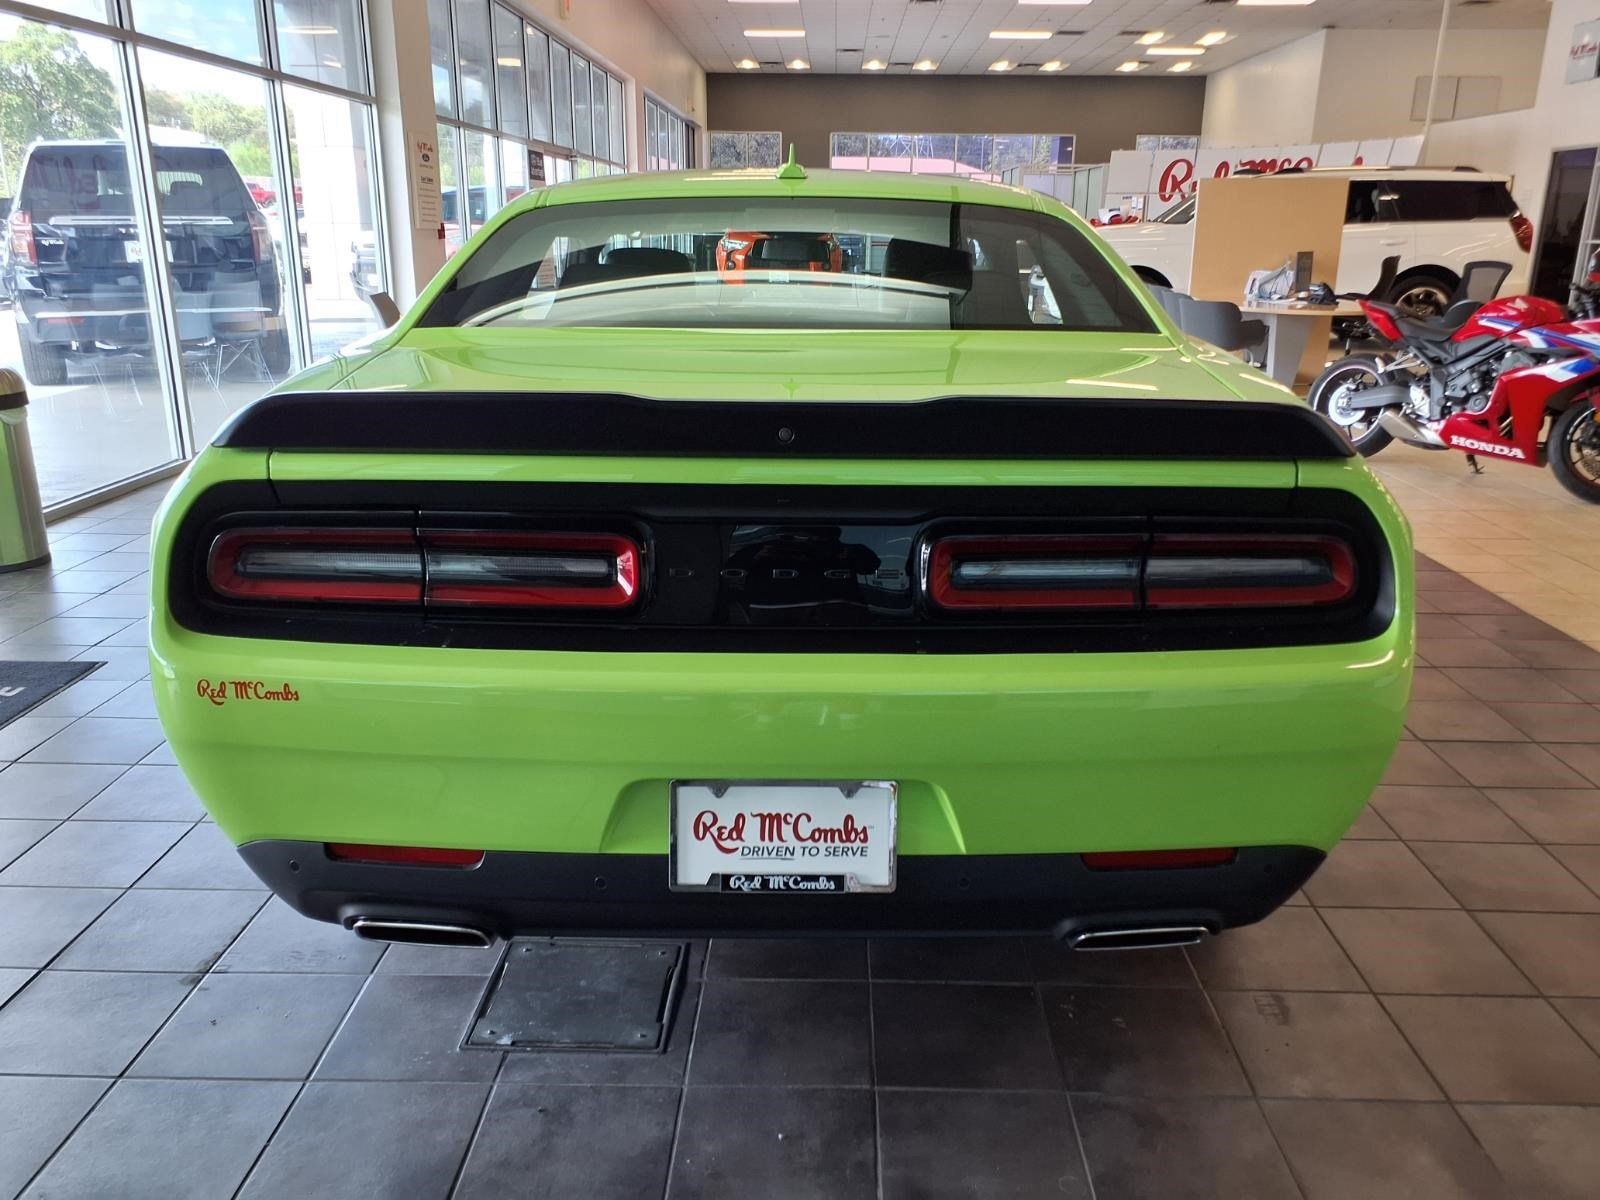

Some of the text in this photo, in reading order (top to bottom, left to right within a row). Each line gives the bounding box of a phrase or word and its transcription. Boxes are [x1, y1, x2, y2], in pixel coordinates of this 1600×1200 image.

[1450, 435, 1526, 459] HONDA
[197, 679, 299, 705] Red McCombs
[693, 810, 869, 854] Red McCombs
[741, 846, 869, 857] DRIVEN TO SERVE
[729, 875, 835, 892] Red McCombs
